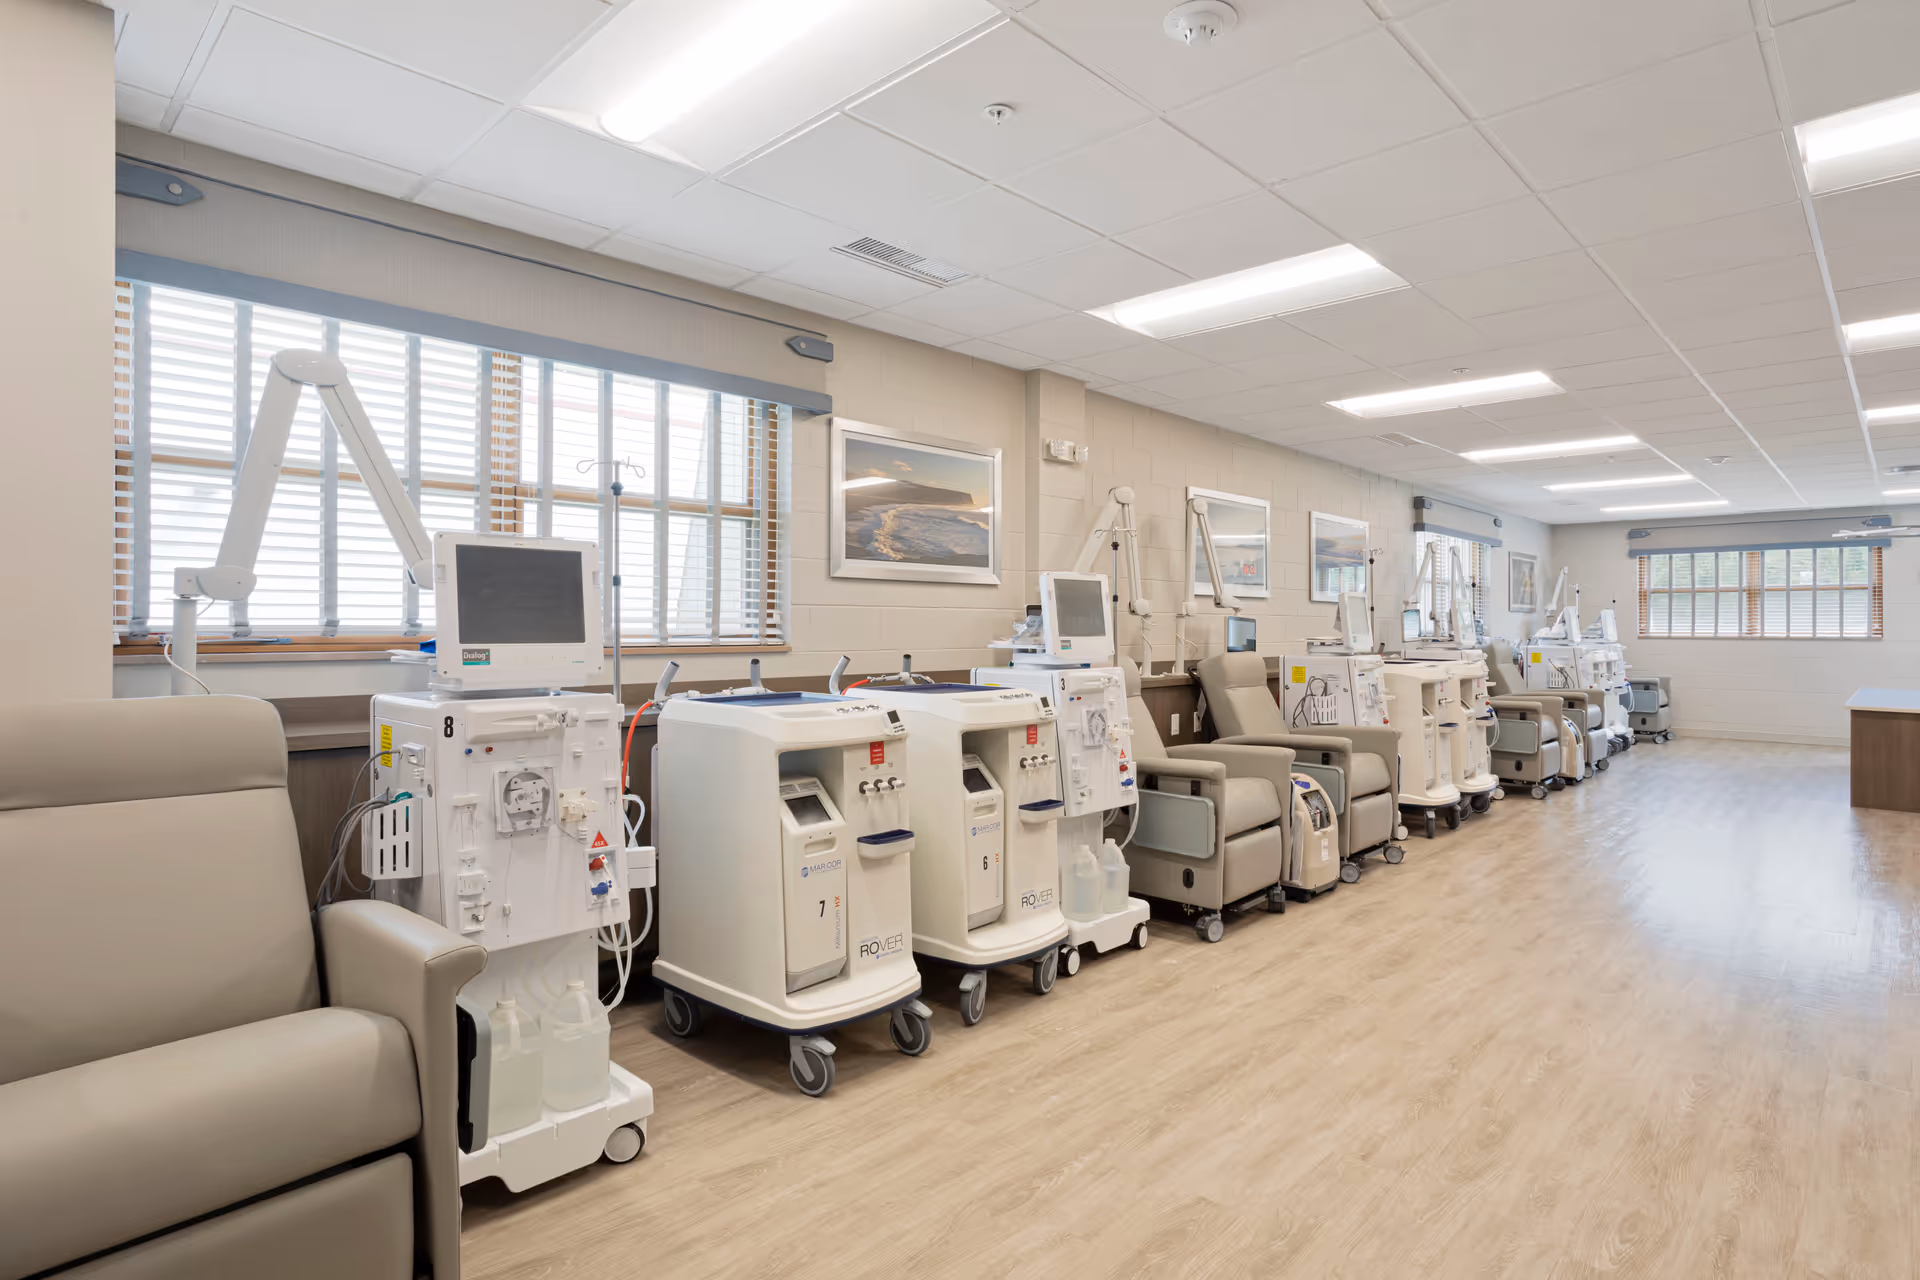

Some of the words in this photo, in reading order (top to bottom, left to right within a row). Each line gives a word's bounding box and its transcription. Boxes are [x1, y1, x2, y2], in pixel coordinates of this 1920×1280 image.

[1061, 678, 1066, 690] 3
[444, 716, 454, 738] 8
[983, 856, 989, 870] 6
[1021, 888, 1053, 908] ROVER
[819, 900, 826, 918] 7
[860, 933, 904, 958] ROVER
